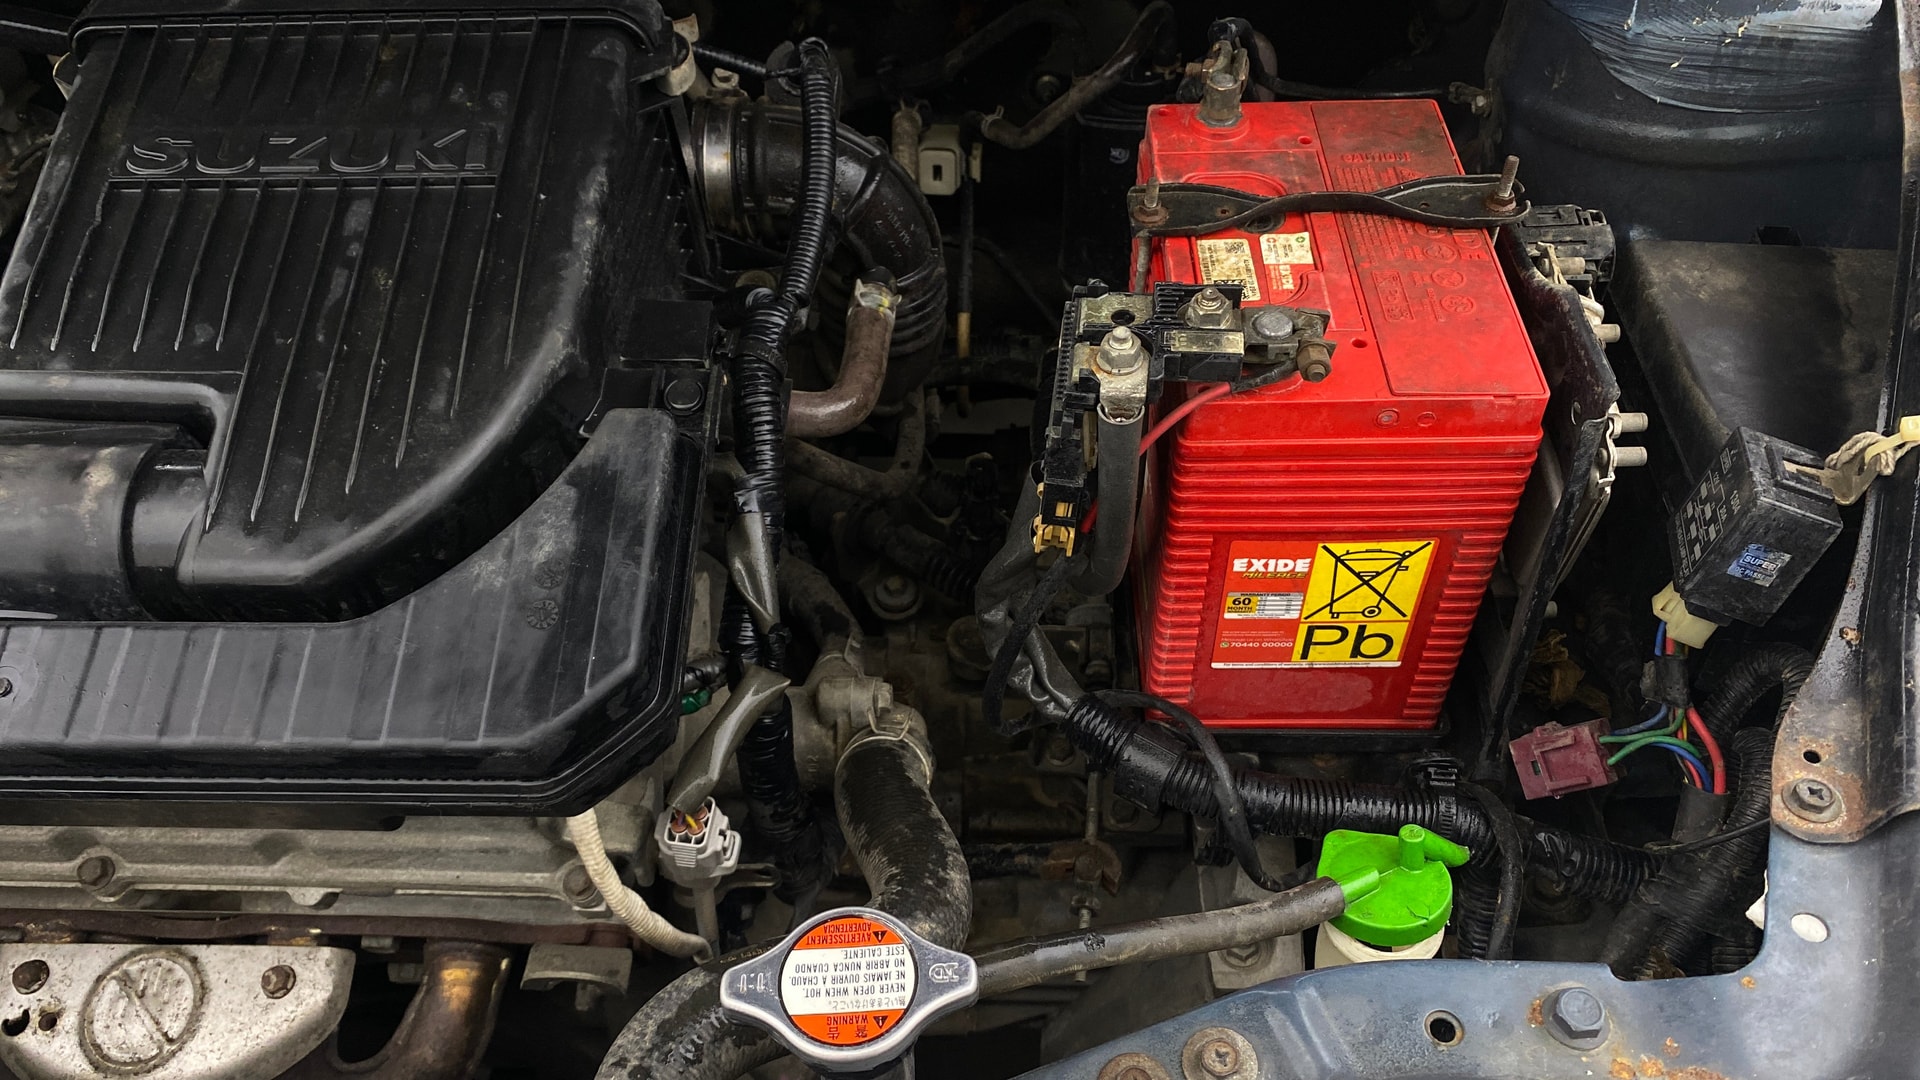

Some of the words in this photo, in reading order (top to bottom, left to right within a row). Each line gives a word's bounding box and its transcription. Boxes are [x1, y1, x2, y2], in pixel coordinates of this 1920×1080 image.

[126, 129, 487, 175] SUZUKI
[1232, 558, 1312, 573] EXIDE
[1743, 555, 1778, 571] SUPER
[1232, 597, 1251, 605] 60
[1300, 624, 1394, 660] Pb
[823, 922, 872, 933] ADVERTENCIA
[806, 932, 872, 945] AVERTISSEMENT
[841, 947, 882, 959] CALIENTE.
[886, 946, 905, 956] ESTE
[795, 963, 829, 974] CUANDO
[833, 961, 861, 972] NUNCA
[866, 959, 890, 970] ABRIR
[894, 958, 905, 968] NO
[831, 973, 860, 984] OUVRIR
[864, 971, 892, 983] JAMAIS
[896, 971, 905, 979] NE
[789, 976, 819, 986] CHAUD.
[802, 988, 821, 998] HOT.
[825, 987, 849, 997] WHEN
[853, 985, 875, 995] OPEN
[879, 983, 905, 993] NEVER
[827, 1014, 868, 1025] WARNING
